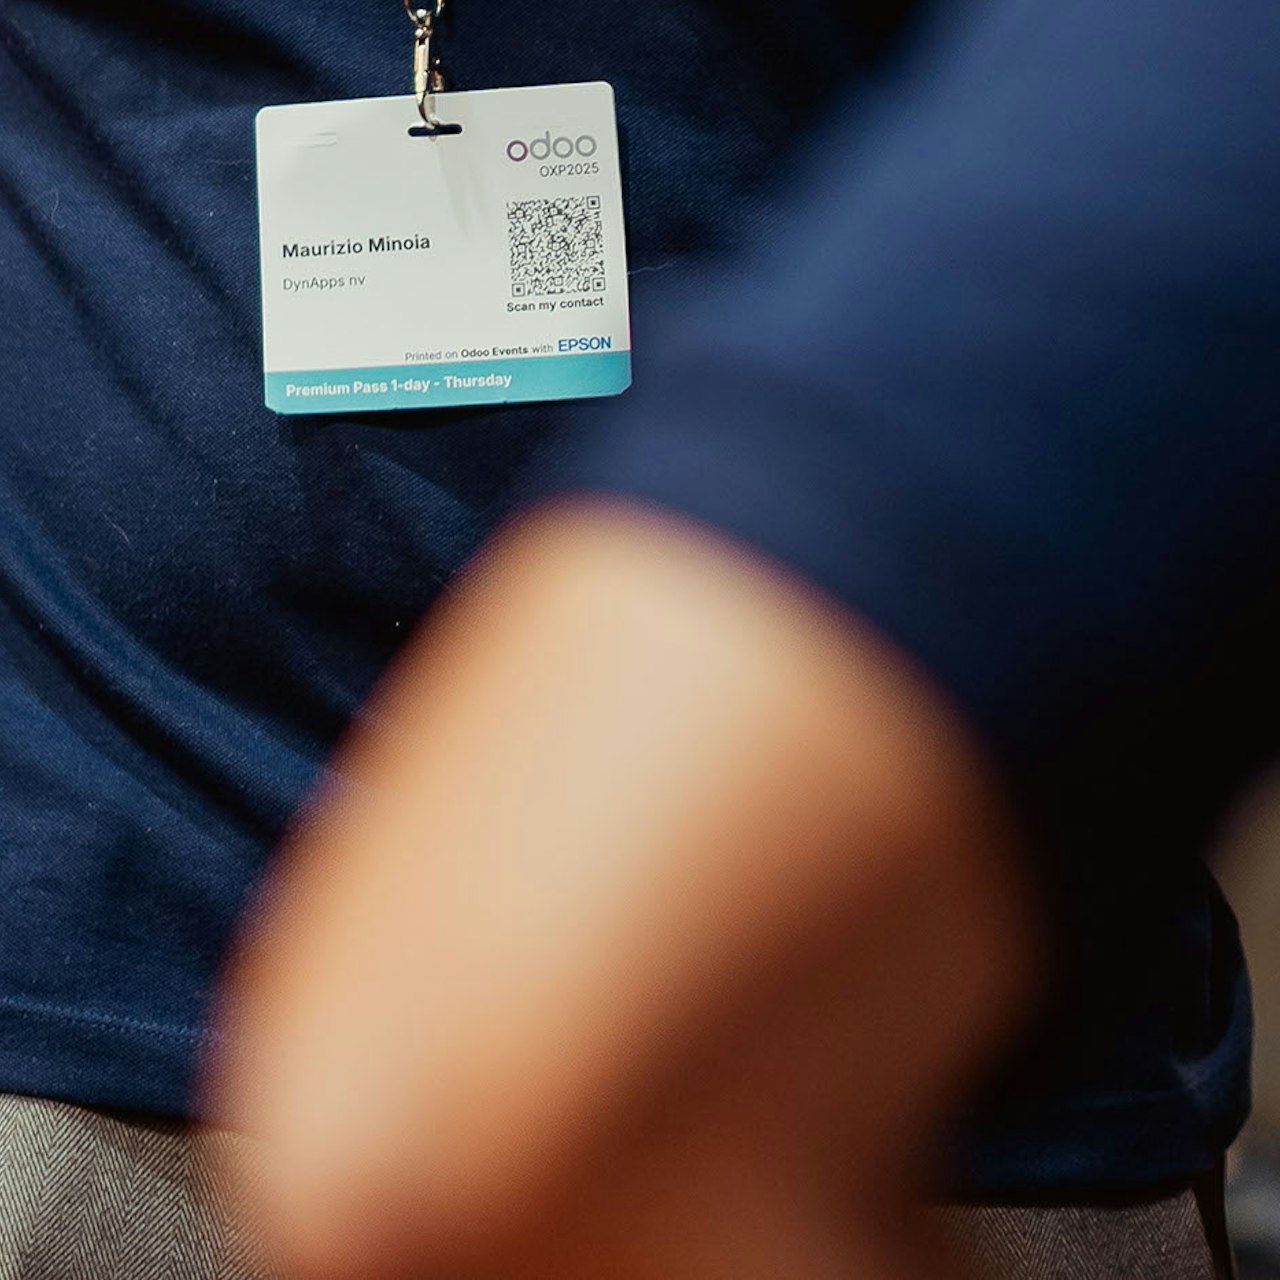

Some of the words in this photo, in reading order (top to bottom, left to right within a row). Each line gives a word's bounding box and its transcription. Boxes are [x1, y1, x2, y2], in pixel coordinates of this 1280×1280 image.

[506, 130, 598, 162] odoo
[539, 161, 600, 178] OXP2025
[282, 238, 363, 258] Maurizio
[369, 234, 431, 253] Minoia
[282, 276, 346, 293] DynApps
[349, 276, 366, 287] nv
[506, 302, 536, 313] Scan
[538, 301, 557, 312] my
[559, 296, 605, 309] contact
[405, 351, 443, 362] Printed
[444, 350, 459, 360] on
[460, 348, 490, 359] Odoo
[491, 345, 529, 357] Events
[532, 343, 554, 354] with
[558, 336, 612, 352] EPSON
[286, 382, 350, 397] Premium
[353, 380, 388, 394] Pass
[390, 378, 431, 392] 1-day
[443, 373, 513, 389] Thursday
